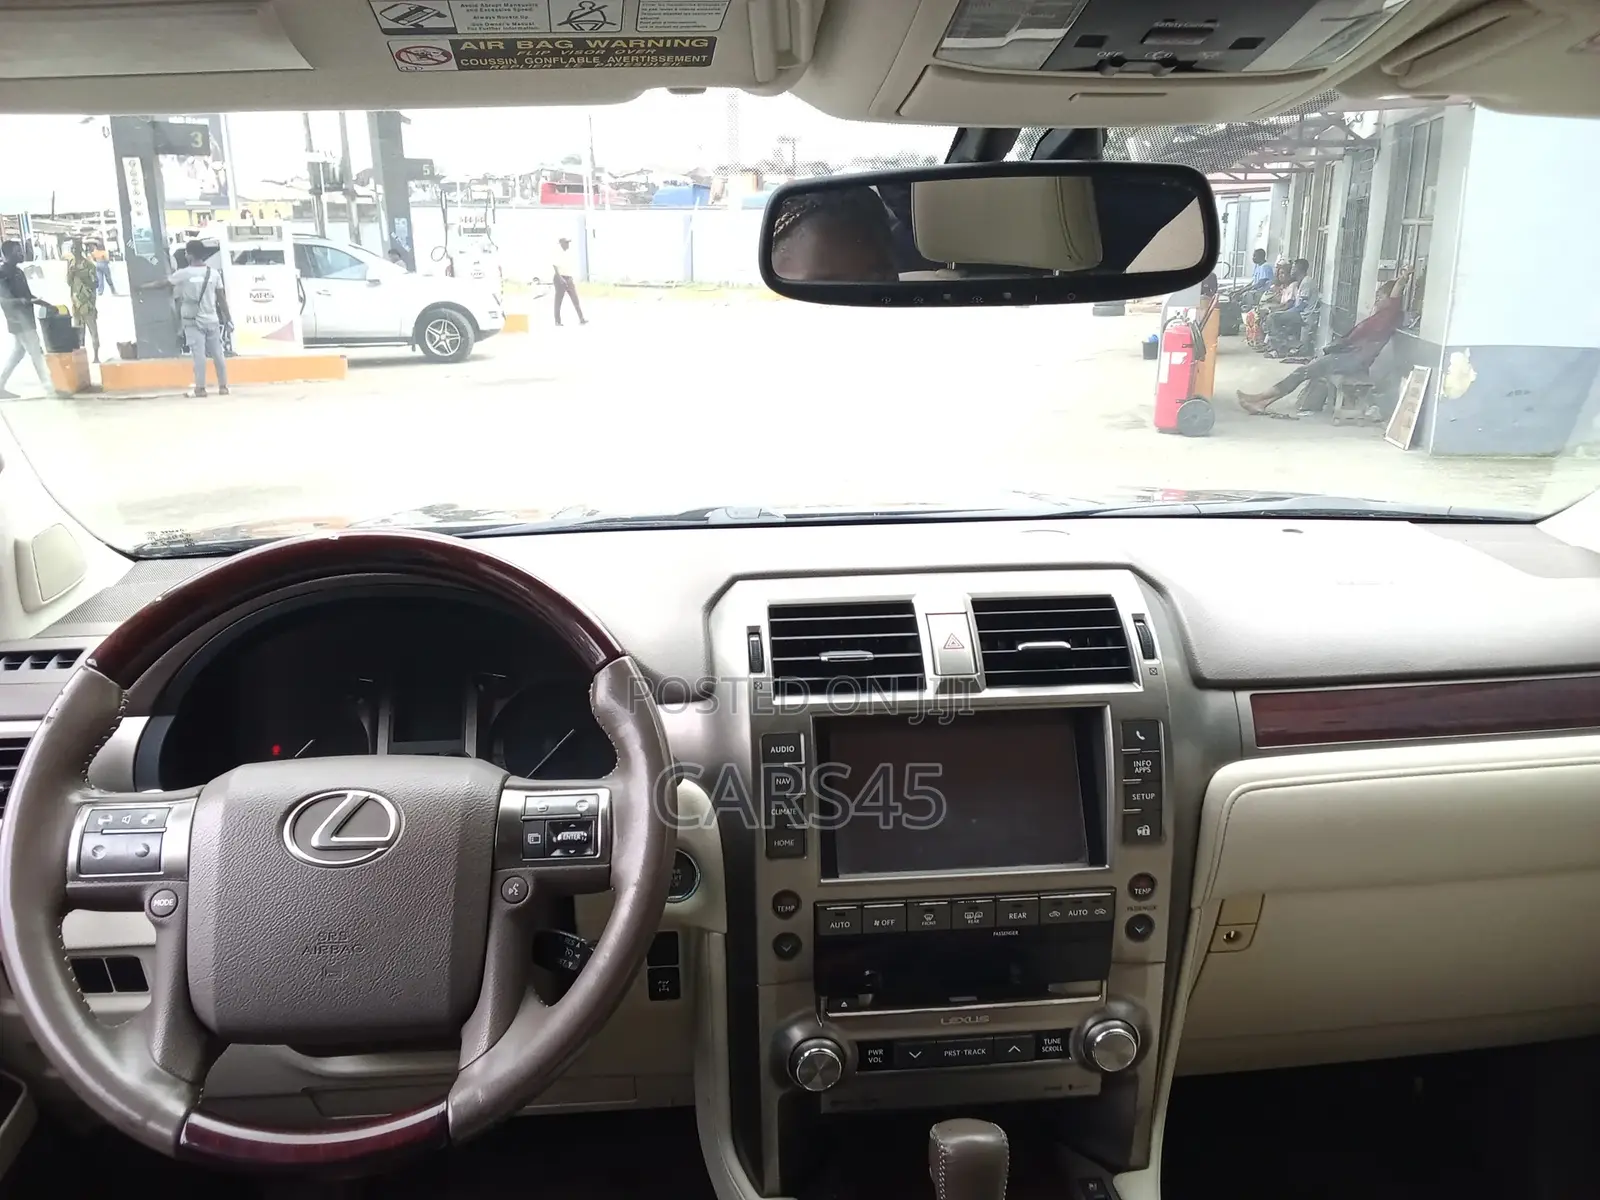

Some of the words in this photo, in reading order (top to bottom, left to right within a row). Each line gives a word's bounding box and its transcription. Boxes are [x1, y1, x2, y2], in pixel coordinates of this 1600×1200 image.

[460, 40, 505, 50] AIR
[516, 40, 573, 50] BAG
[586, 38, 709, 49] WARNING
[460, 57, 517, 66] COUSSIN
[524, 57, 600, 65] GONFLABLE
[607, 55, 708, 64] AVERTISSEMENT
[189, 131, 204, 148] 3
[422, 164, 431, 176] 5
[770, 745, 795, 754] AUDIO
[1133, 759, 1152, 768] INFO
[1132, 793, 1156, 801] SETUP
[771, 808, 796, 816] CLIMATE
[774, 839, 795, 847] HOME
[1134, 887, 1152, 895] TEMP
[153, 898, 174, 907] MODE
[777, 905, 796, 913] TEMP
[1068, 909, 1089, 917] AUTO
[1008, 912, 1028, 920] REAR
[829, 921, 851, 929] AUTO
[881, 919, 896, 927] OFF
[940, 1015, 990, 1025] LEXUS
[1041, 1044, 1063, 1052] SCROLL
